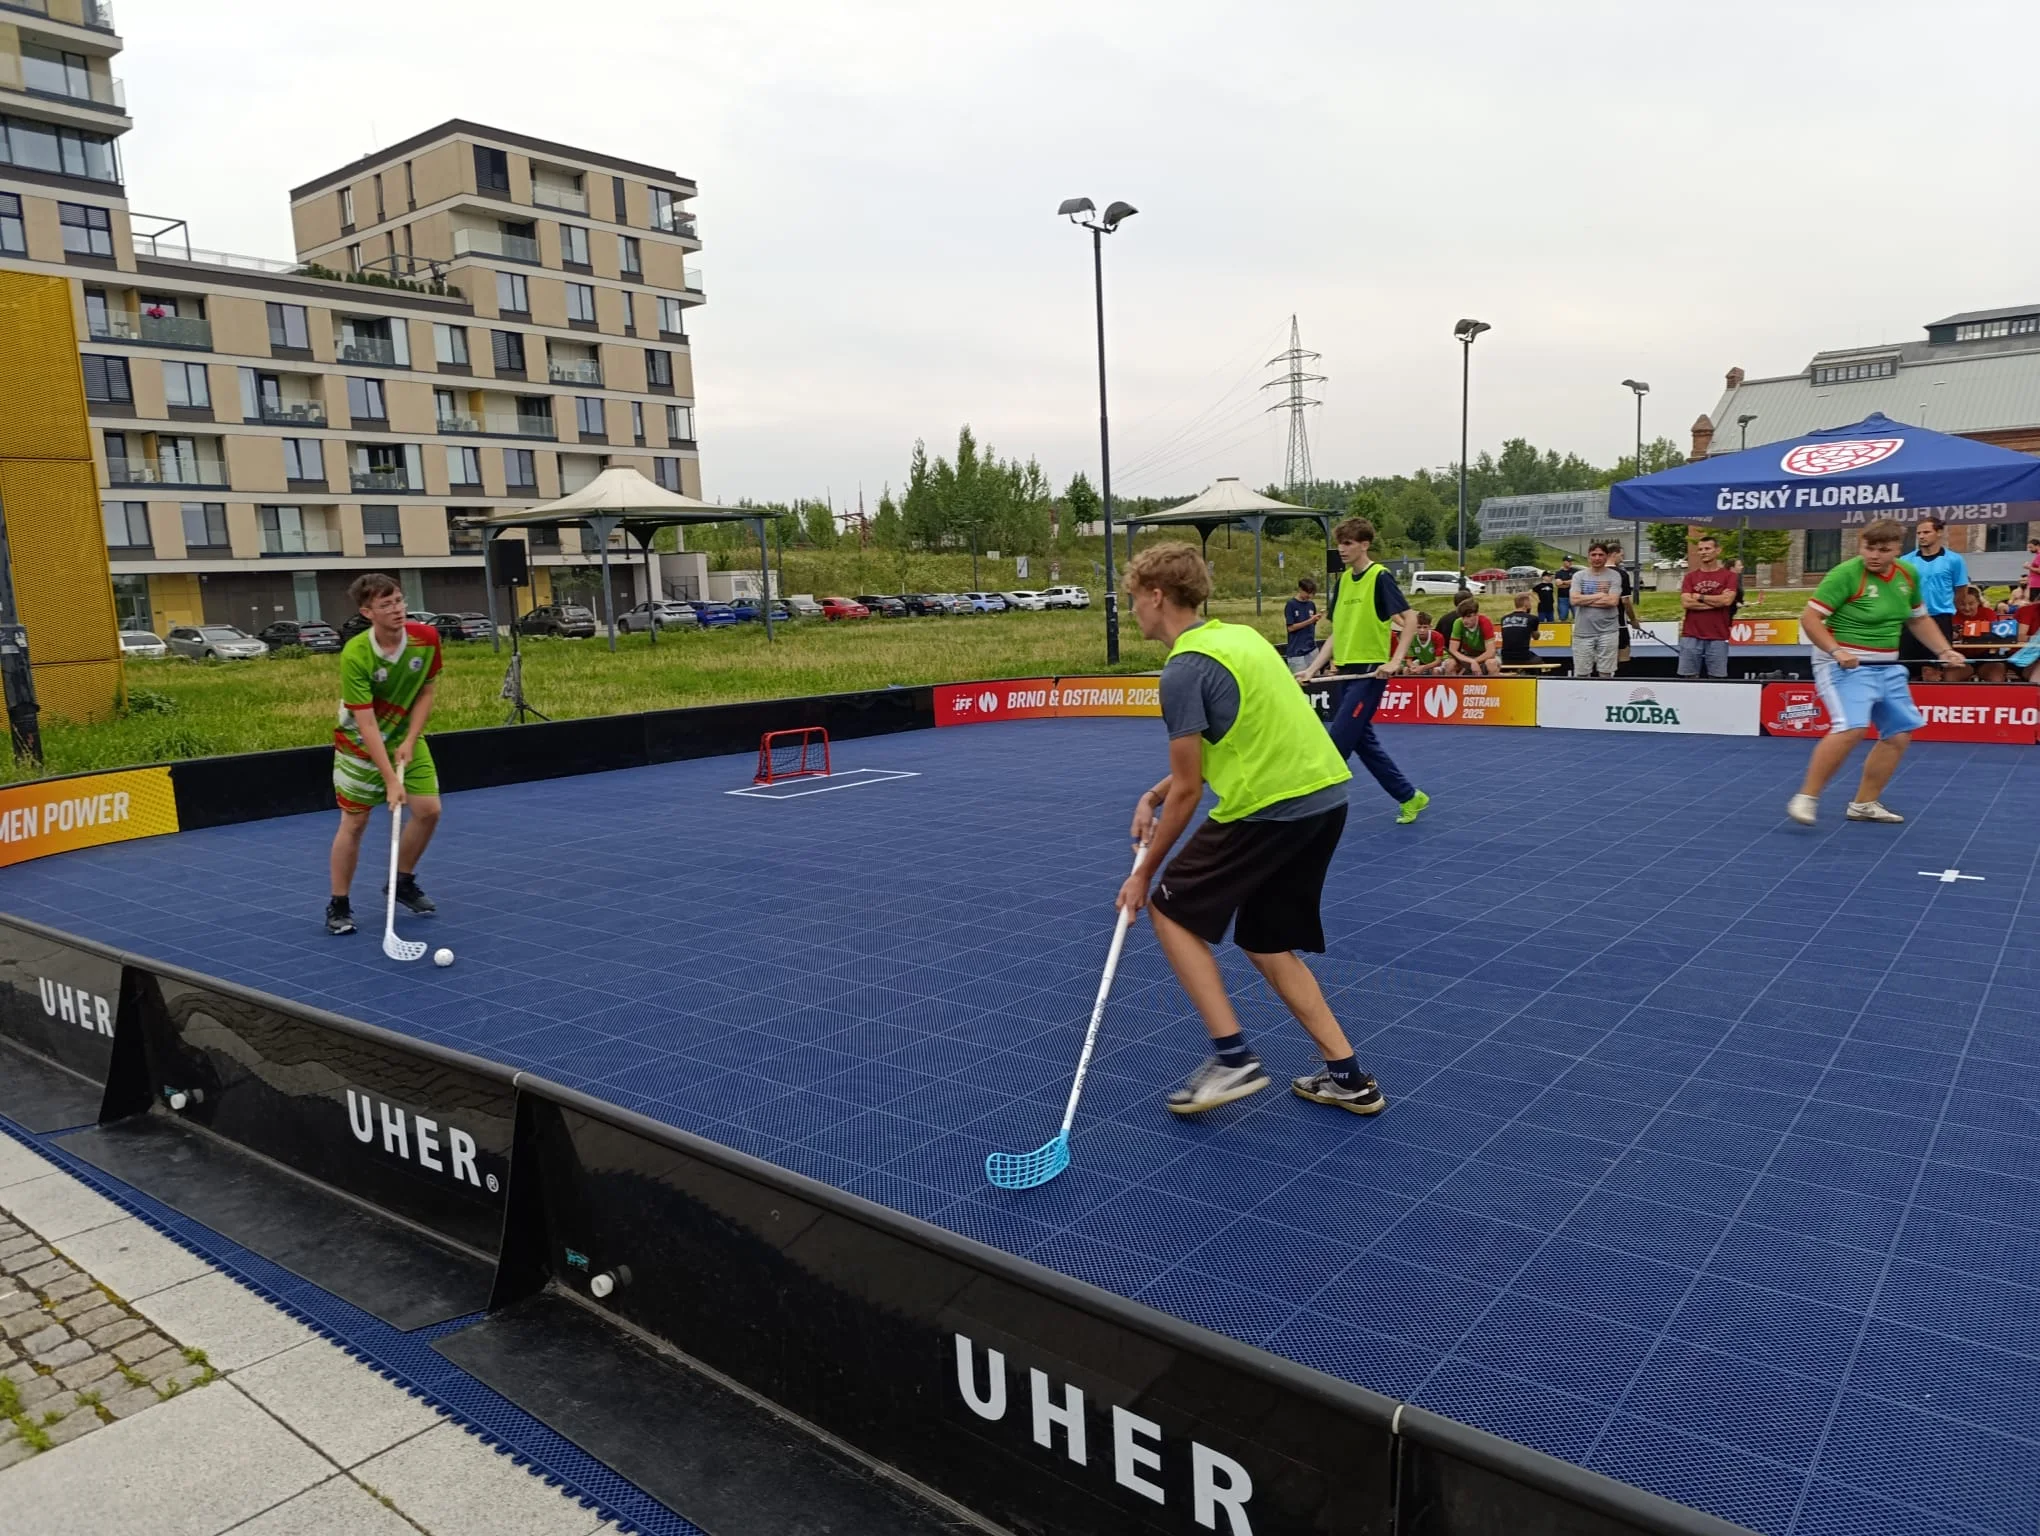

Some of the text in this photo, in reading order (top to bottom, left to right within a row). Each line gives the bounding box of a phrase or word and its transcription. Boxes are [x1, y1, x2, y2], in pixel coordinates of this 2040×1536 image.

[1717, 483, 1904, 511] ČESKÝ FLORBAL
[1007, 688, 1160, 709] BRNO & OSTRAVA 2025
[1463, 684, 1488, 695] BRNO
[1463, 696, 1500, 707] OSTRAVA
[1463, 708, 1485, 719] 2025
[1605, 705, 1680, 725] HOLBA
[1919, 705, 1990, 724] TREET
[44, 791, 130, 835] POWER
[39, 976, 115, 1039] UHER
[955, 1333, 1254, 1536] UHER
